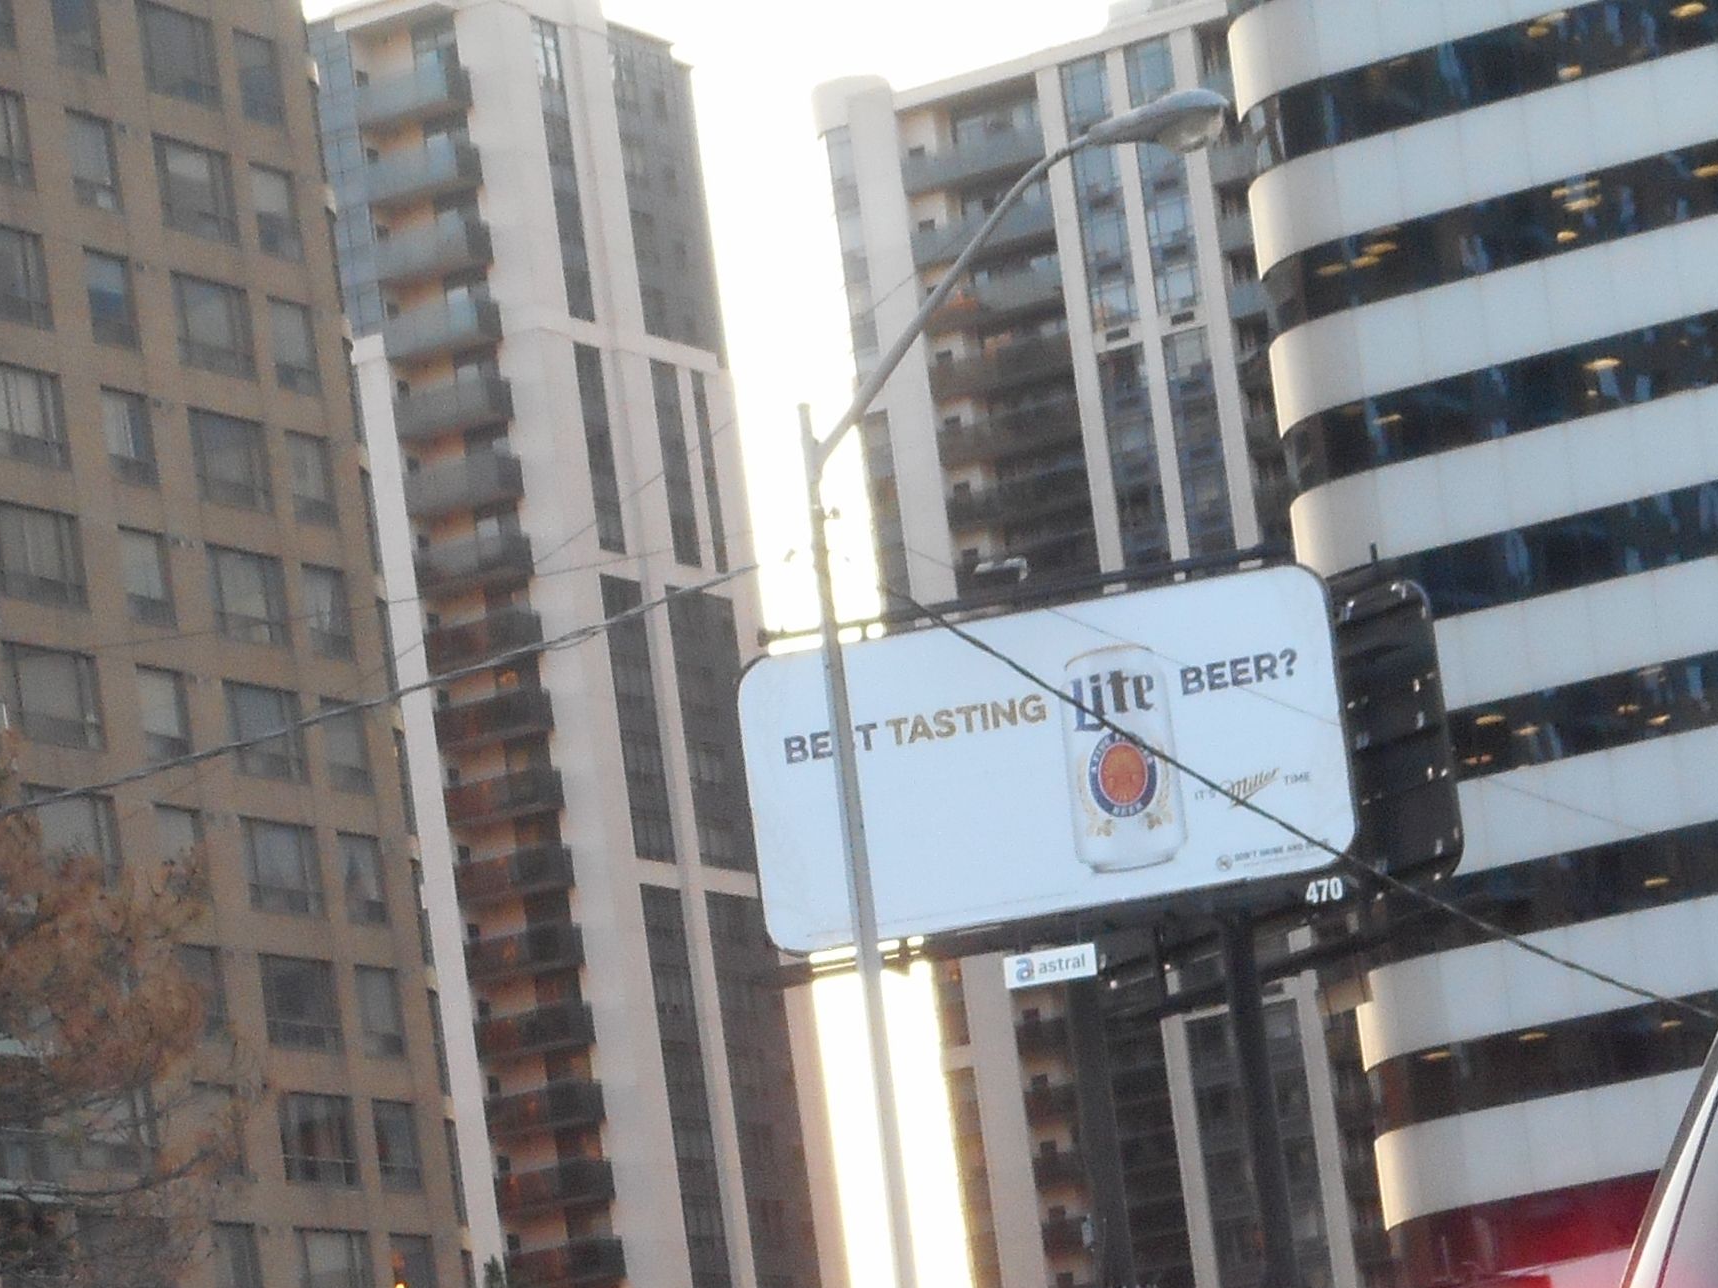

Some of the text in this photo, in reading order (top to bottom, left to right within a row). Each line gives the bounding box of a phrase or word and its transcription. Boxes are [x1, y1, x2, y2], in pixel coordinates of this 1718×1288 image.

[1180, 648, 1297, 696] BEER?
[1070, 670, 1154, 732] Lite
[784, 694, 1047, 764] BET TASTING
[1305, 876, 1343, 904] 470
[1039, 953, 1086, 974] astral
